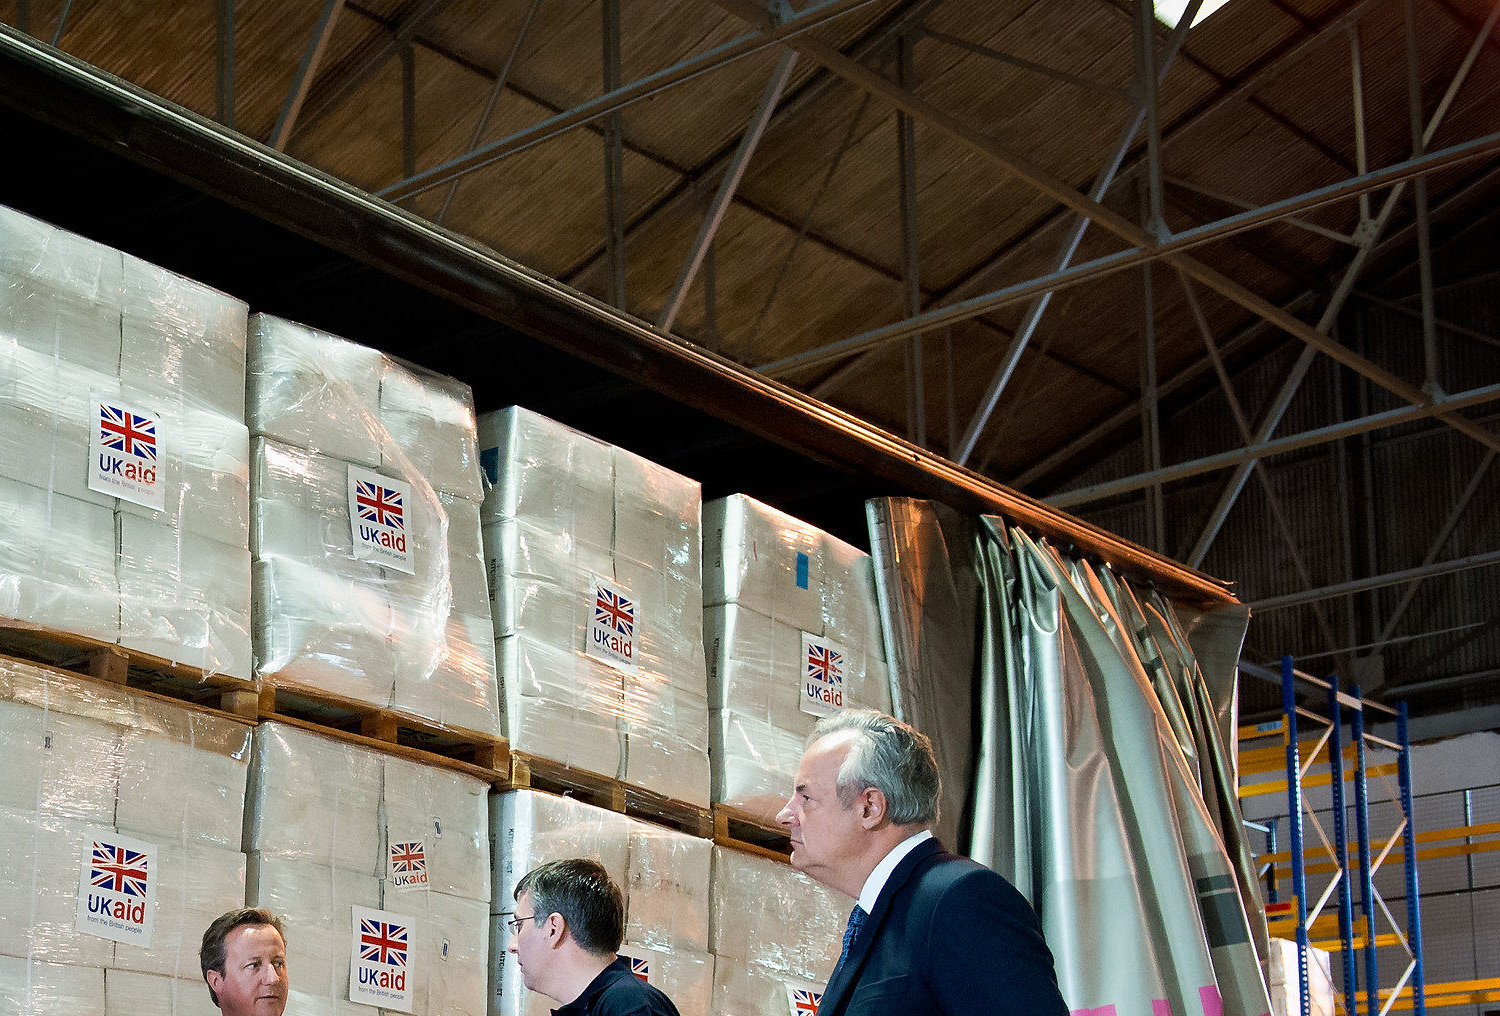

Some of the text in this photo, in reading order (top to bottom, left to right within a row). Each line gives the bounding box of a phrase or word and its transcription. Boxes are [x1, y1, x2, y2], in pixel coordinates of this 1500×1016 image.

[100, 453, 156, 487] UKaid
[359, 524, 406, 553] UKaid
[593, 627, 632, 658] UKaid
[806, 683, 843, 707] UKaid
[394, 871, 428, 886] UKaid
[88, 894, 146, 925] UKaid
[358, 966, 406, 991] UKaid
